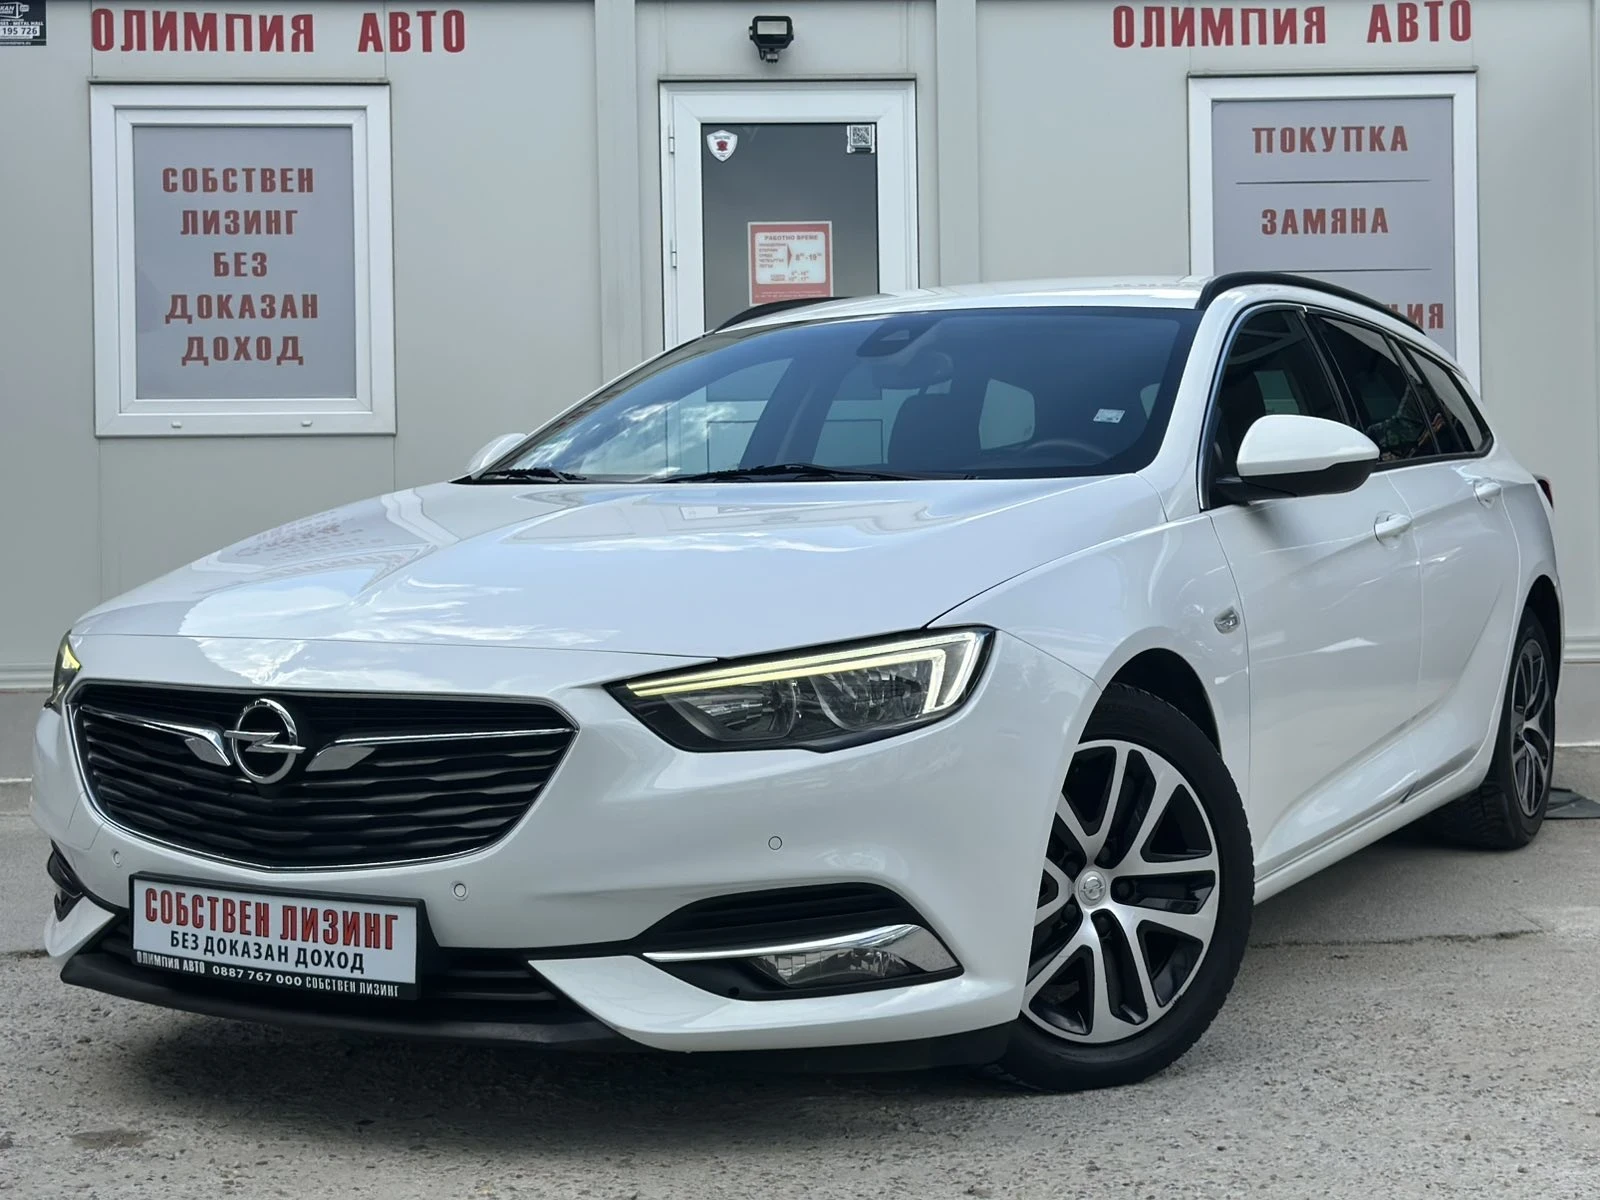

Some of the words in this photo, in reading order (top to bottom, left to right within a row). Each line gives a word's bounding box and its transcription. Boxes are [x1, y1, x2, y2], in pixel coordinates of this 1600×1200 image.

[2, 27, 18, 35] 195
[21, 27, 38, 35] 726
[91, 8, 314, 52] ОЛИМПИЯ
[358, 9, 466, 53] АВТО
[1112, 5, 1326, 48] ОЛИМПИЯ
[1366, 0, 1472, 43] АВТО
[1252, 125, 1408, 154] ПОКУПКА
[162, 167, 314, 193] СОБСТВЕН
[180, 210, 298, 236] ЛИЗИНГ
[1261, 207, 1389, 235] ЗАМЯНА
[213, 252, 268, 277] БЕЗ
[165, 294, 318, 325] ДОКАЗАН
[181, 336, 304, 366] ДОХОД
[145, 888, 270, 938] СОБСТВЕН
[280, 905, 398, 950] ЛИЗИНГ
[170, 930, 199, 951] БЕЗ
[203, 936, 289, 963] ДОКАЗАН
[295, 947, 364, 974] ДОХОД
[136, 951, 180, 970] ОЛИМПИЯ
[182, 959, 205, 974] АВТО
[212, 965, 243, 978] 0887
[247, 970, 272, 982] 767
[275, 974, 302, 986] 000
[305, 976, 356, 993] СОБСТВЕН
[359, 982, 400, 998] ЛИЗИНГ
